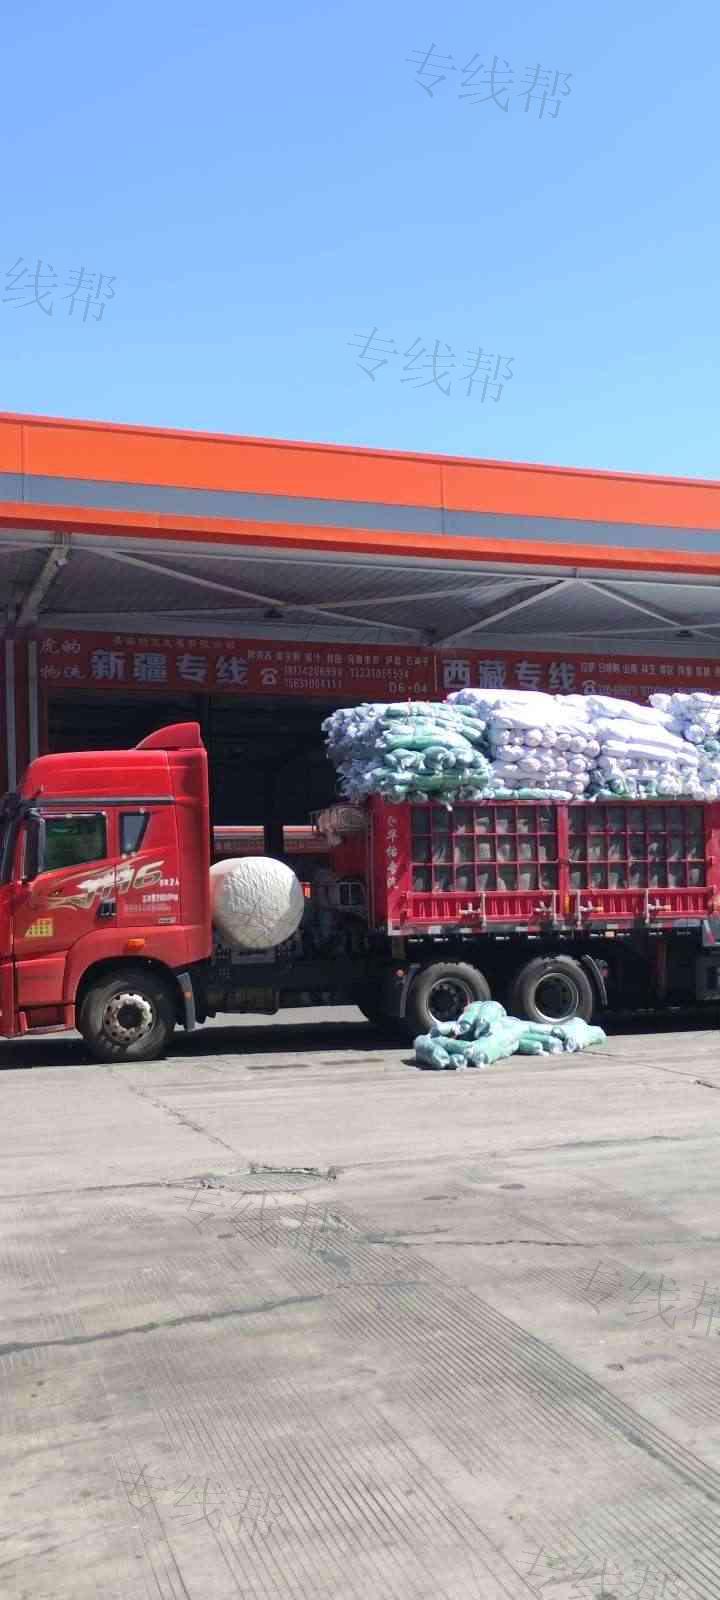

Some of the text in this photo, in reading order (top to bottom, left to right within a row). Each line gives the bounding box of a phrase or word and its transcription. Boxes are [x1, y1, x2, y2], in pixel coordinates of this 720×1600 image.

[90, 649, 249, 686] 新疆专线
[442, 658, 578, 692] 西藏专线
